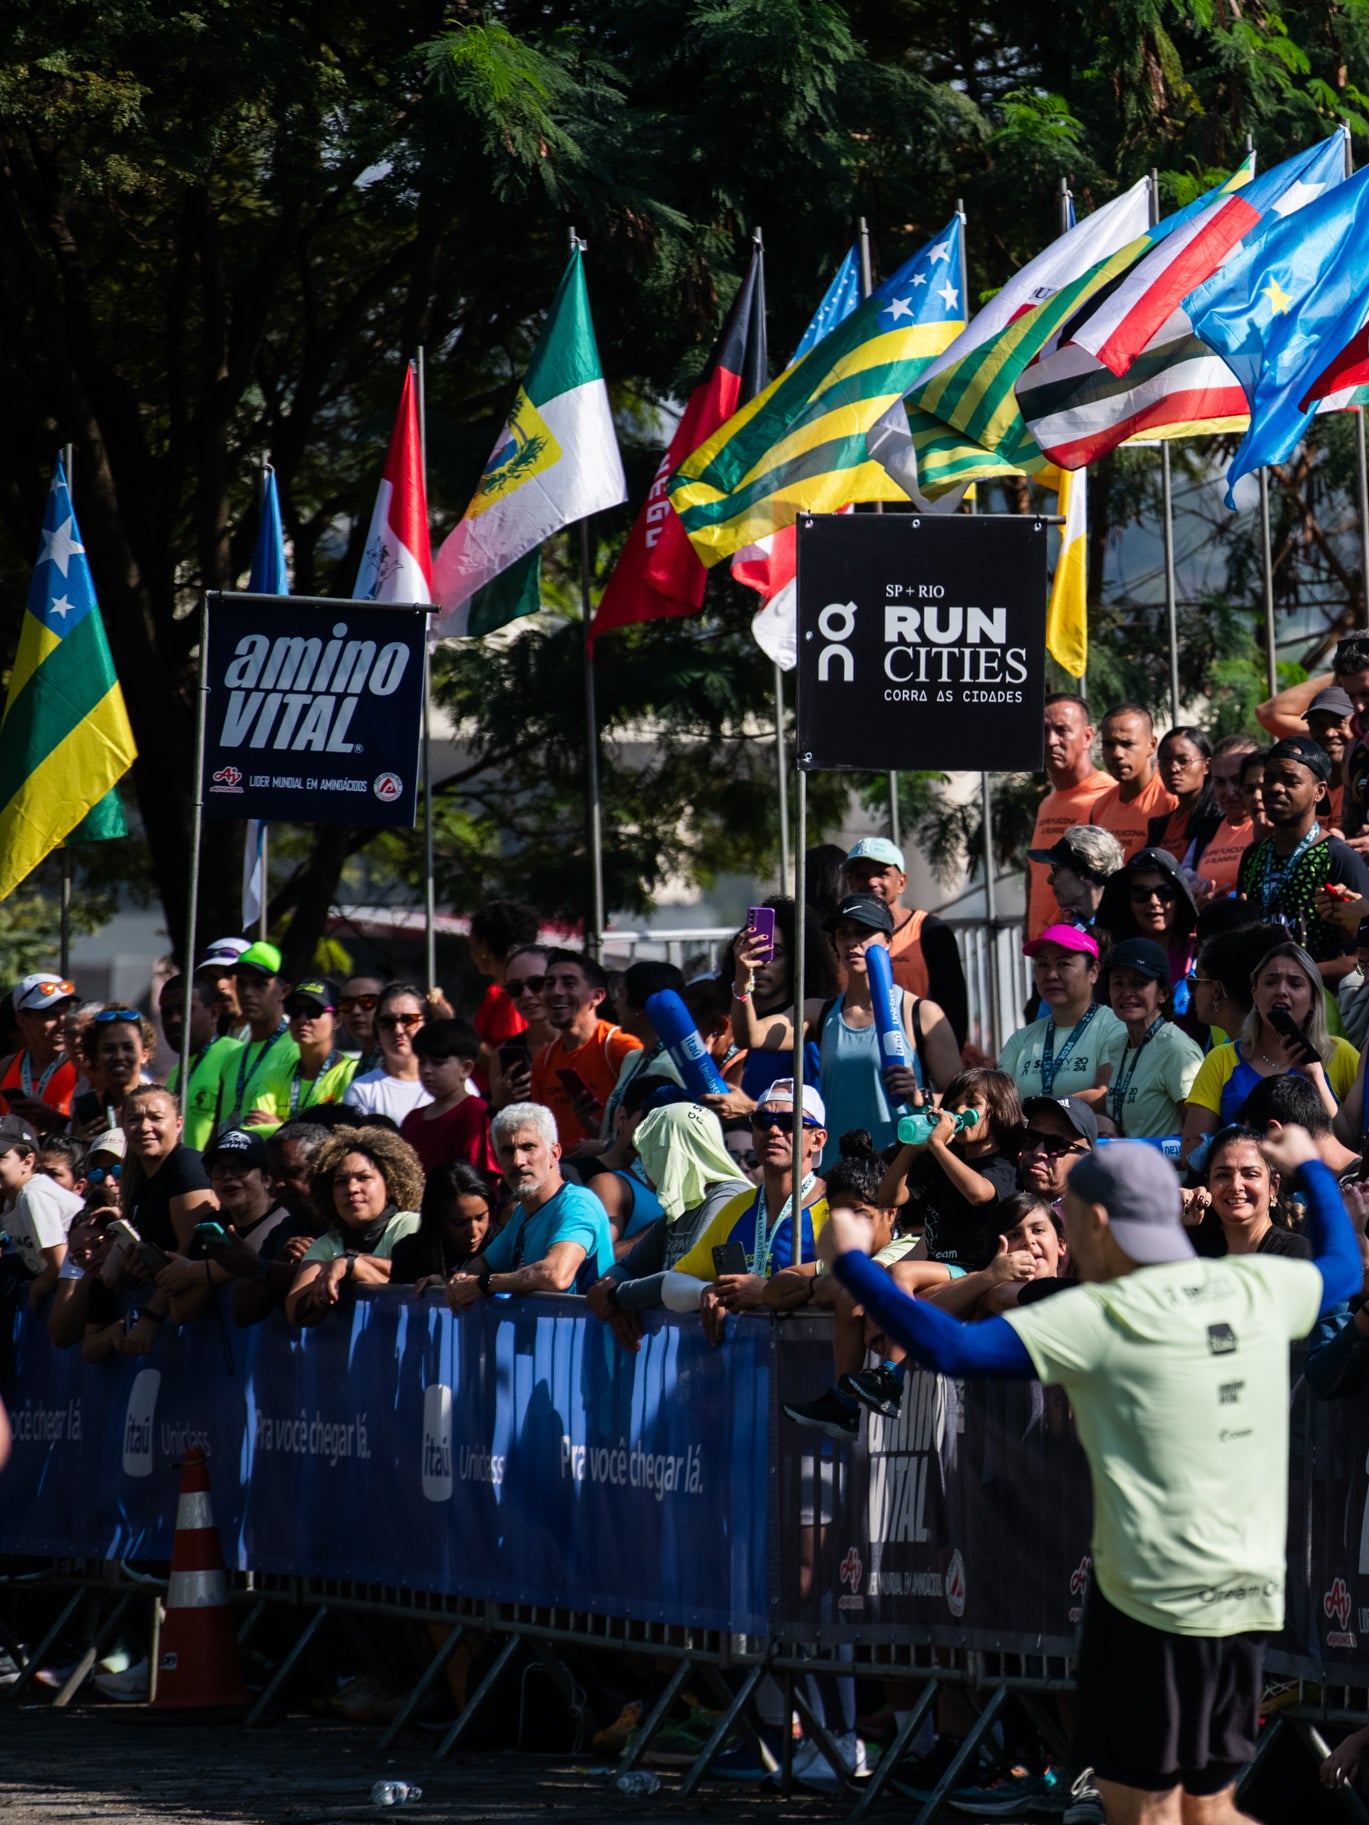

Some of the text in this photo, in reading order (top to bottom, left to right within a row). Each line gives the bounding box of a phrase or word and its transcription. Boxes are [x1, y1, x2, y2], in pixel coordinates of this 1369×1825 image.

[885, 584, 945, 598] SP + RIO
[884, 606, 1007, 644] RUN
[224, 622, 411, 696] amino
[884, 646, 1028, 684] CITIES
[884, 689, 1023, 703] CORRA AS CIDADES
[272, 776, 304, 790] MUNDIAL
[306, 777, 318, 790] EM
[320, 776, 368, 792] AMINOÁCIDOS
[10, 1398, 31, 1441] ocê
[126, 1414, 152, 1454] itaú
[161, 1421, 213, 1457] Uniclass
[255, 1409, 273, 1450] Pra
[276, 1409, 307, 1455] você
[309, 1410, 354, 1467] chegar
[423, 1433, 450, 1478] itaú
[460, 1443, 506, 1485] Uniclass
[561, 1434, 586, 1482] Pra
[590, 1436, 627, 1485] você
[630, 1440, 684, 1502] chegar
